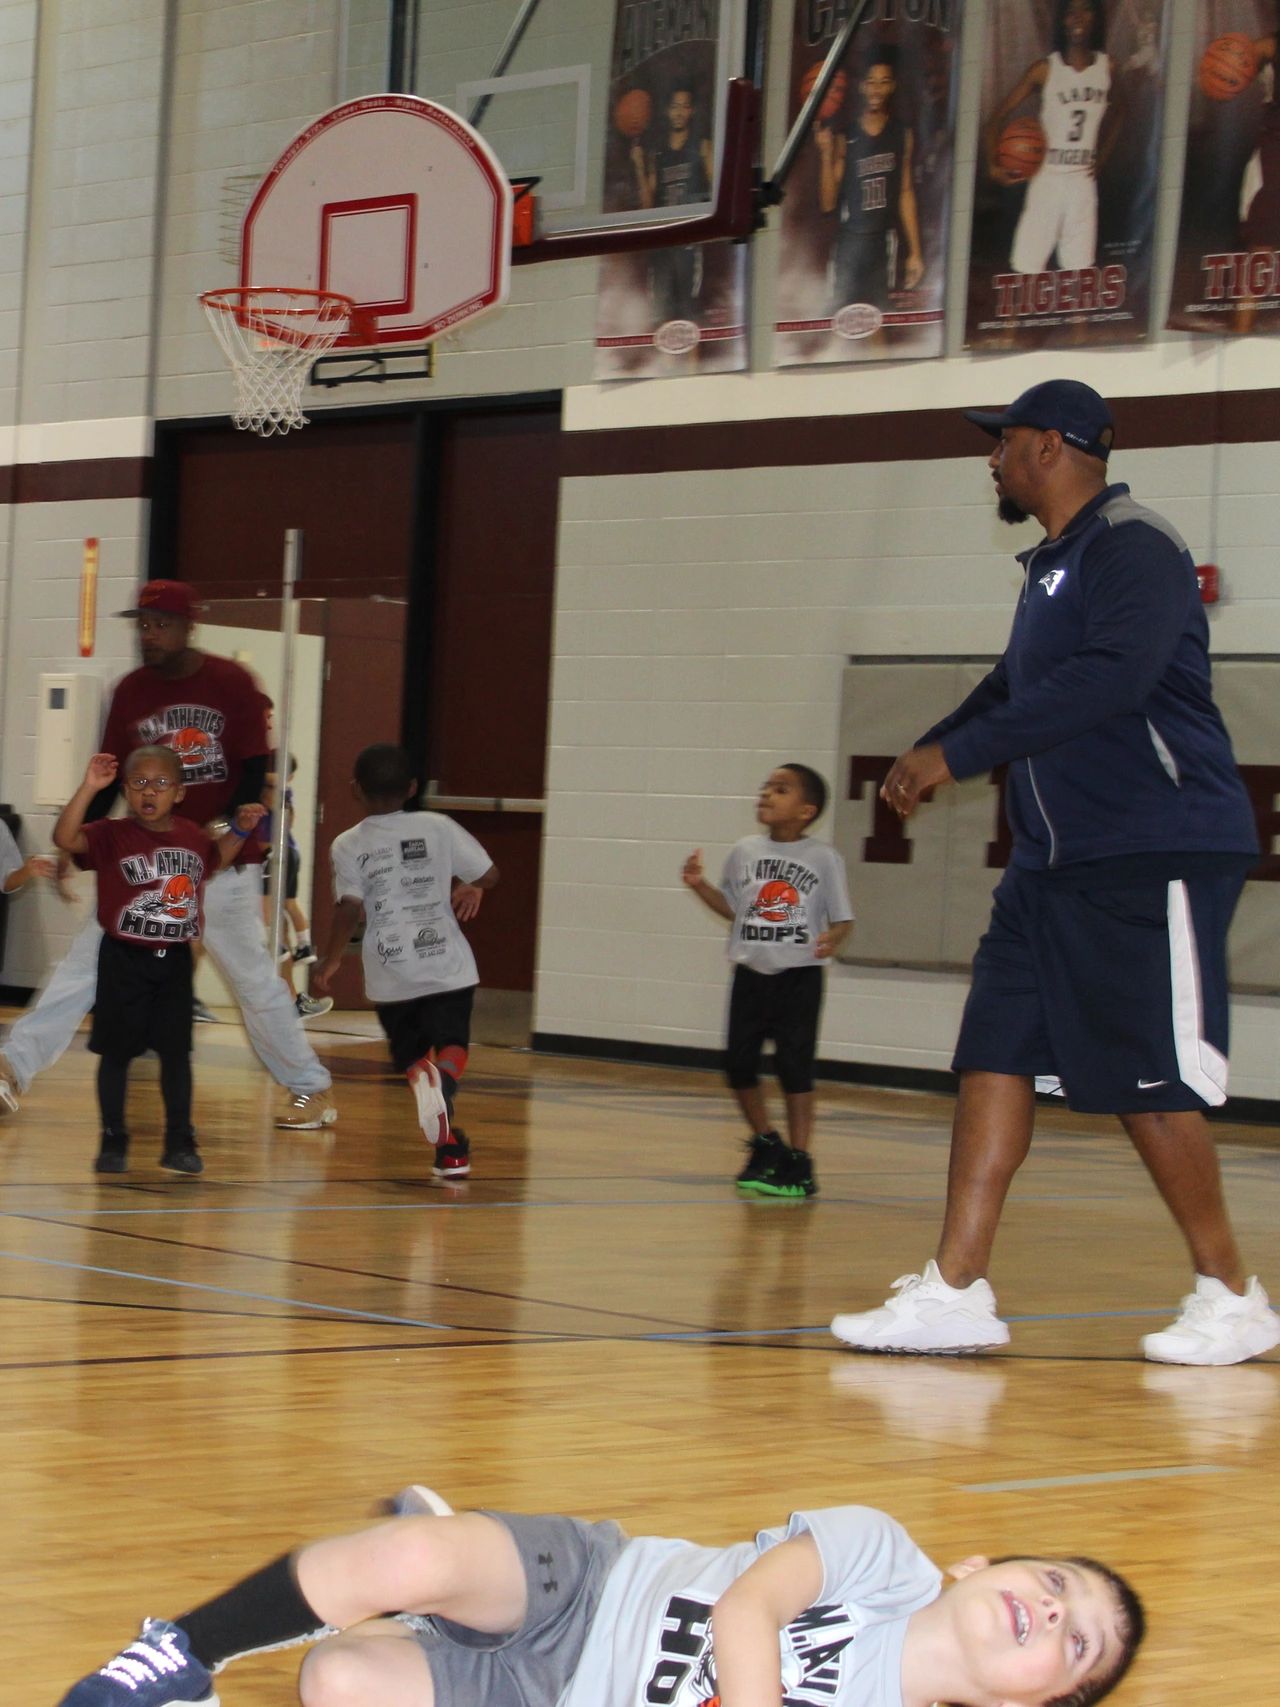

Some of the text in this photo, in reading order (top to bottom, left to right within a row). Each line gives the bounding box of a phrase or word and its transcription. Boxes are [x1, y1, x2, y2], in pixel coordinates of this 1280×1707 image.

[1068, 109, 1087, 142] 3
[993, 265, 1127, 317] TIGERS
[1201, 250, 1280, 300] TIG
[755, 858, 819, 897] ATHLETICS
